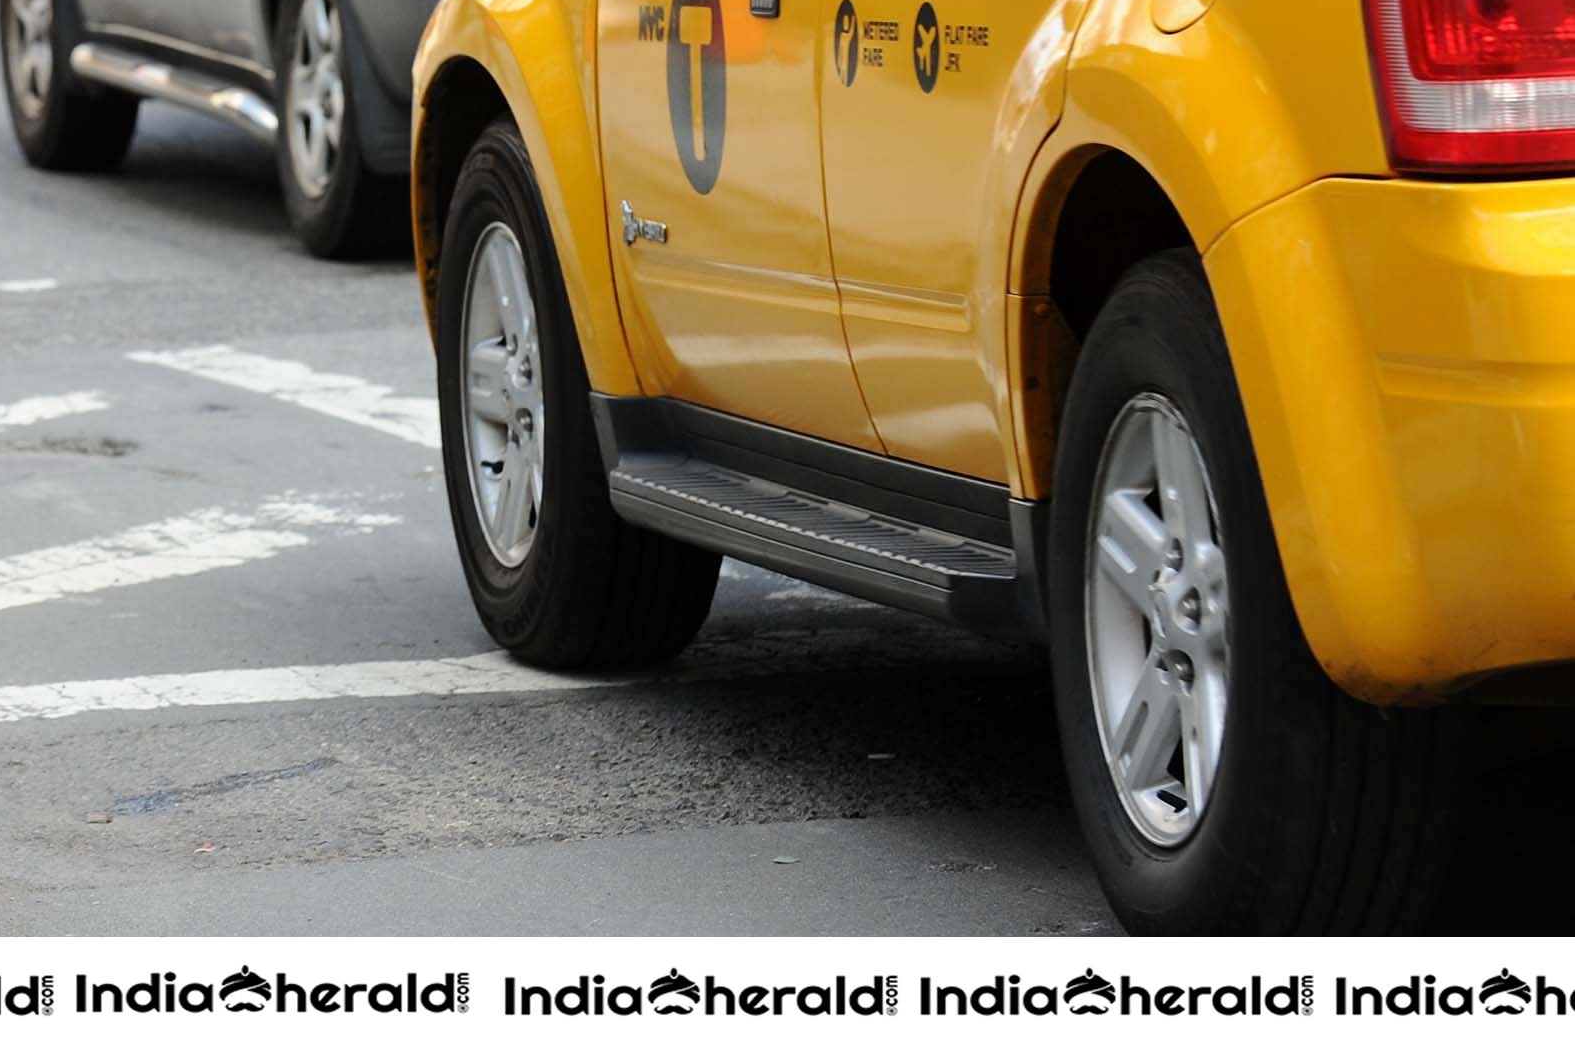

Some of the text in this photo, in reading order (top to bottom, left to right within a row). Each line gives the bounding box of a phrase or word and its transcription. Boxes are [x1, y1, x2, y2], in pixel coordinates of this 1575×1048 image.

[638, 6, 665, 41] NYC
[967, 25, 989, 46] FARE
[863, 47, 883, 67] FARE
